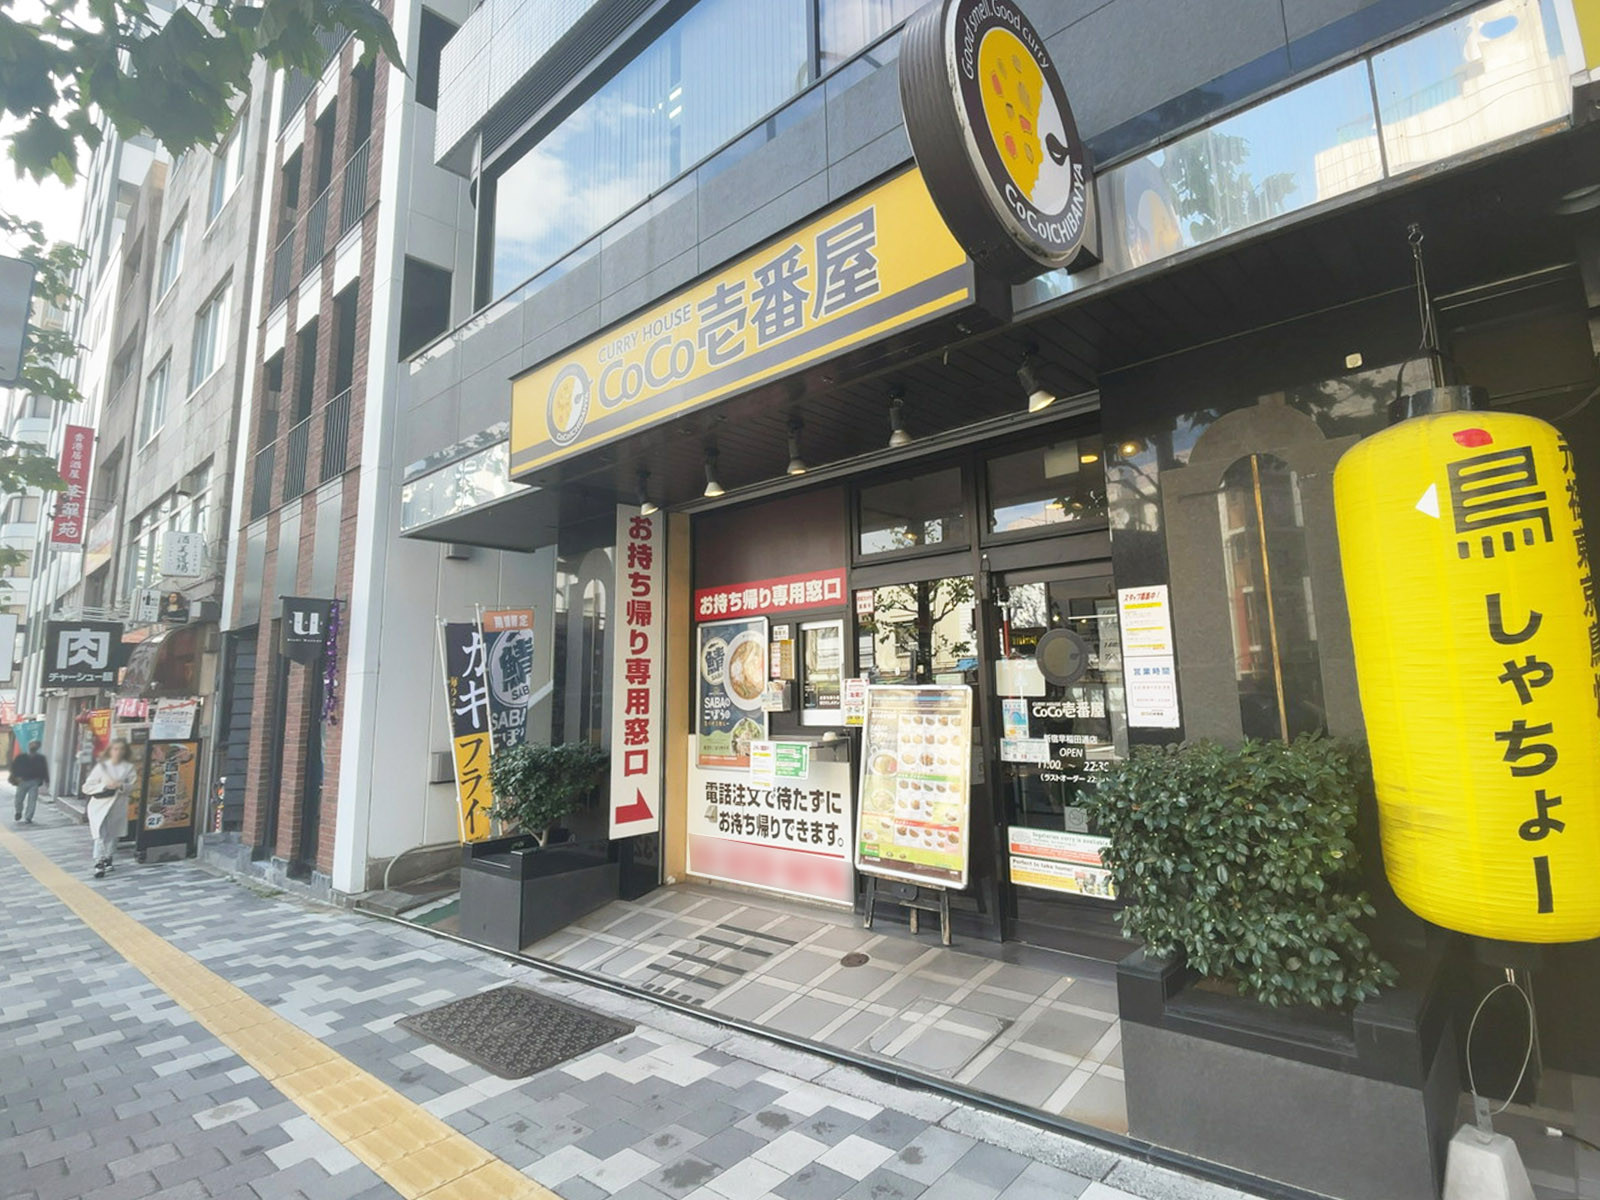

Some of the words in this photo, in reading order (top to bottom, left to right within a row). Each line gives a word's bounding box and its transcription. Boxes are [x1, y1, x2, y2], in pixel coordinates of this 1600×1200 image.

[961, 19, 976, 80] Good
[992, 0, 1021, 32] Good
[1022, 27, 1049, 69] curry
[597, 332, 640, 364] CURRY
[642, 304, 693, 341] HOUSE
[699, 577, 842, 616] お持ち帰り専用窓口
[56, 627, 111, 670] 肉
[623, 515, 652, 777] お持ち帰り専用窓口
[1133, 667, 1170, 675] 営業時間
[1059, 747, 1083, 757] OPEN
[460, 738, 484, 834] フライ
[705, 782, 842, 814] 電話注文で待たずに
[718, 813, 844, 847] お持ち帰りできます。
